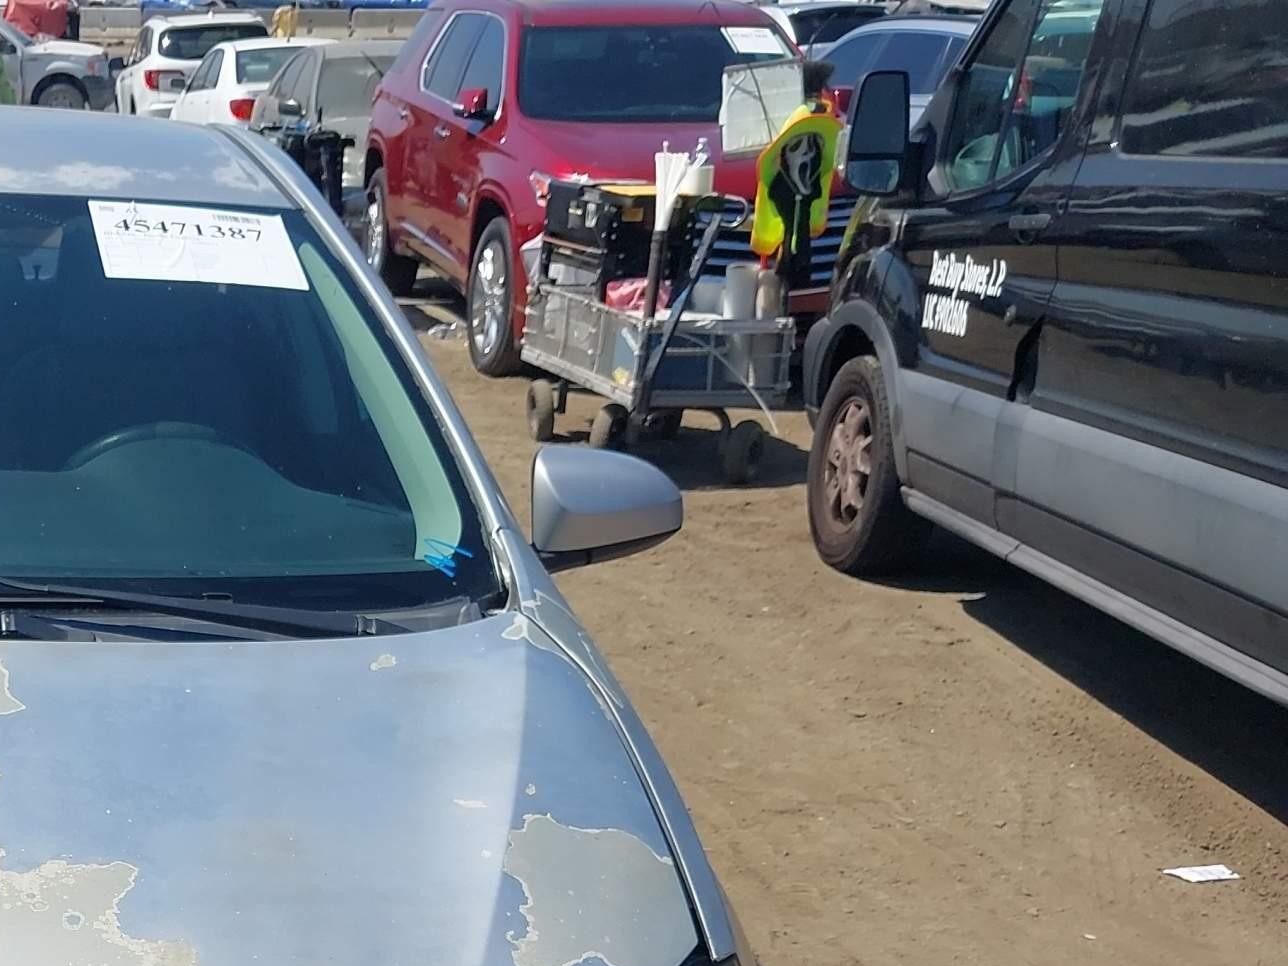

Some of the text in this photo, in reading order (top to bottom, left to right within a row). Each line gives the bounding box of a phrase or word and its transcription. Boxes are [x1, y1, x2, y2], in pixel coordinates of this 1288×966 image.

[114, 218, 262, 242] 45471387
[928, 249, 950, 288] Best
[945, 252, 965, 300] Buy
